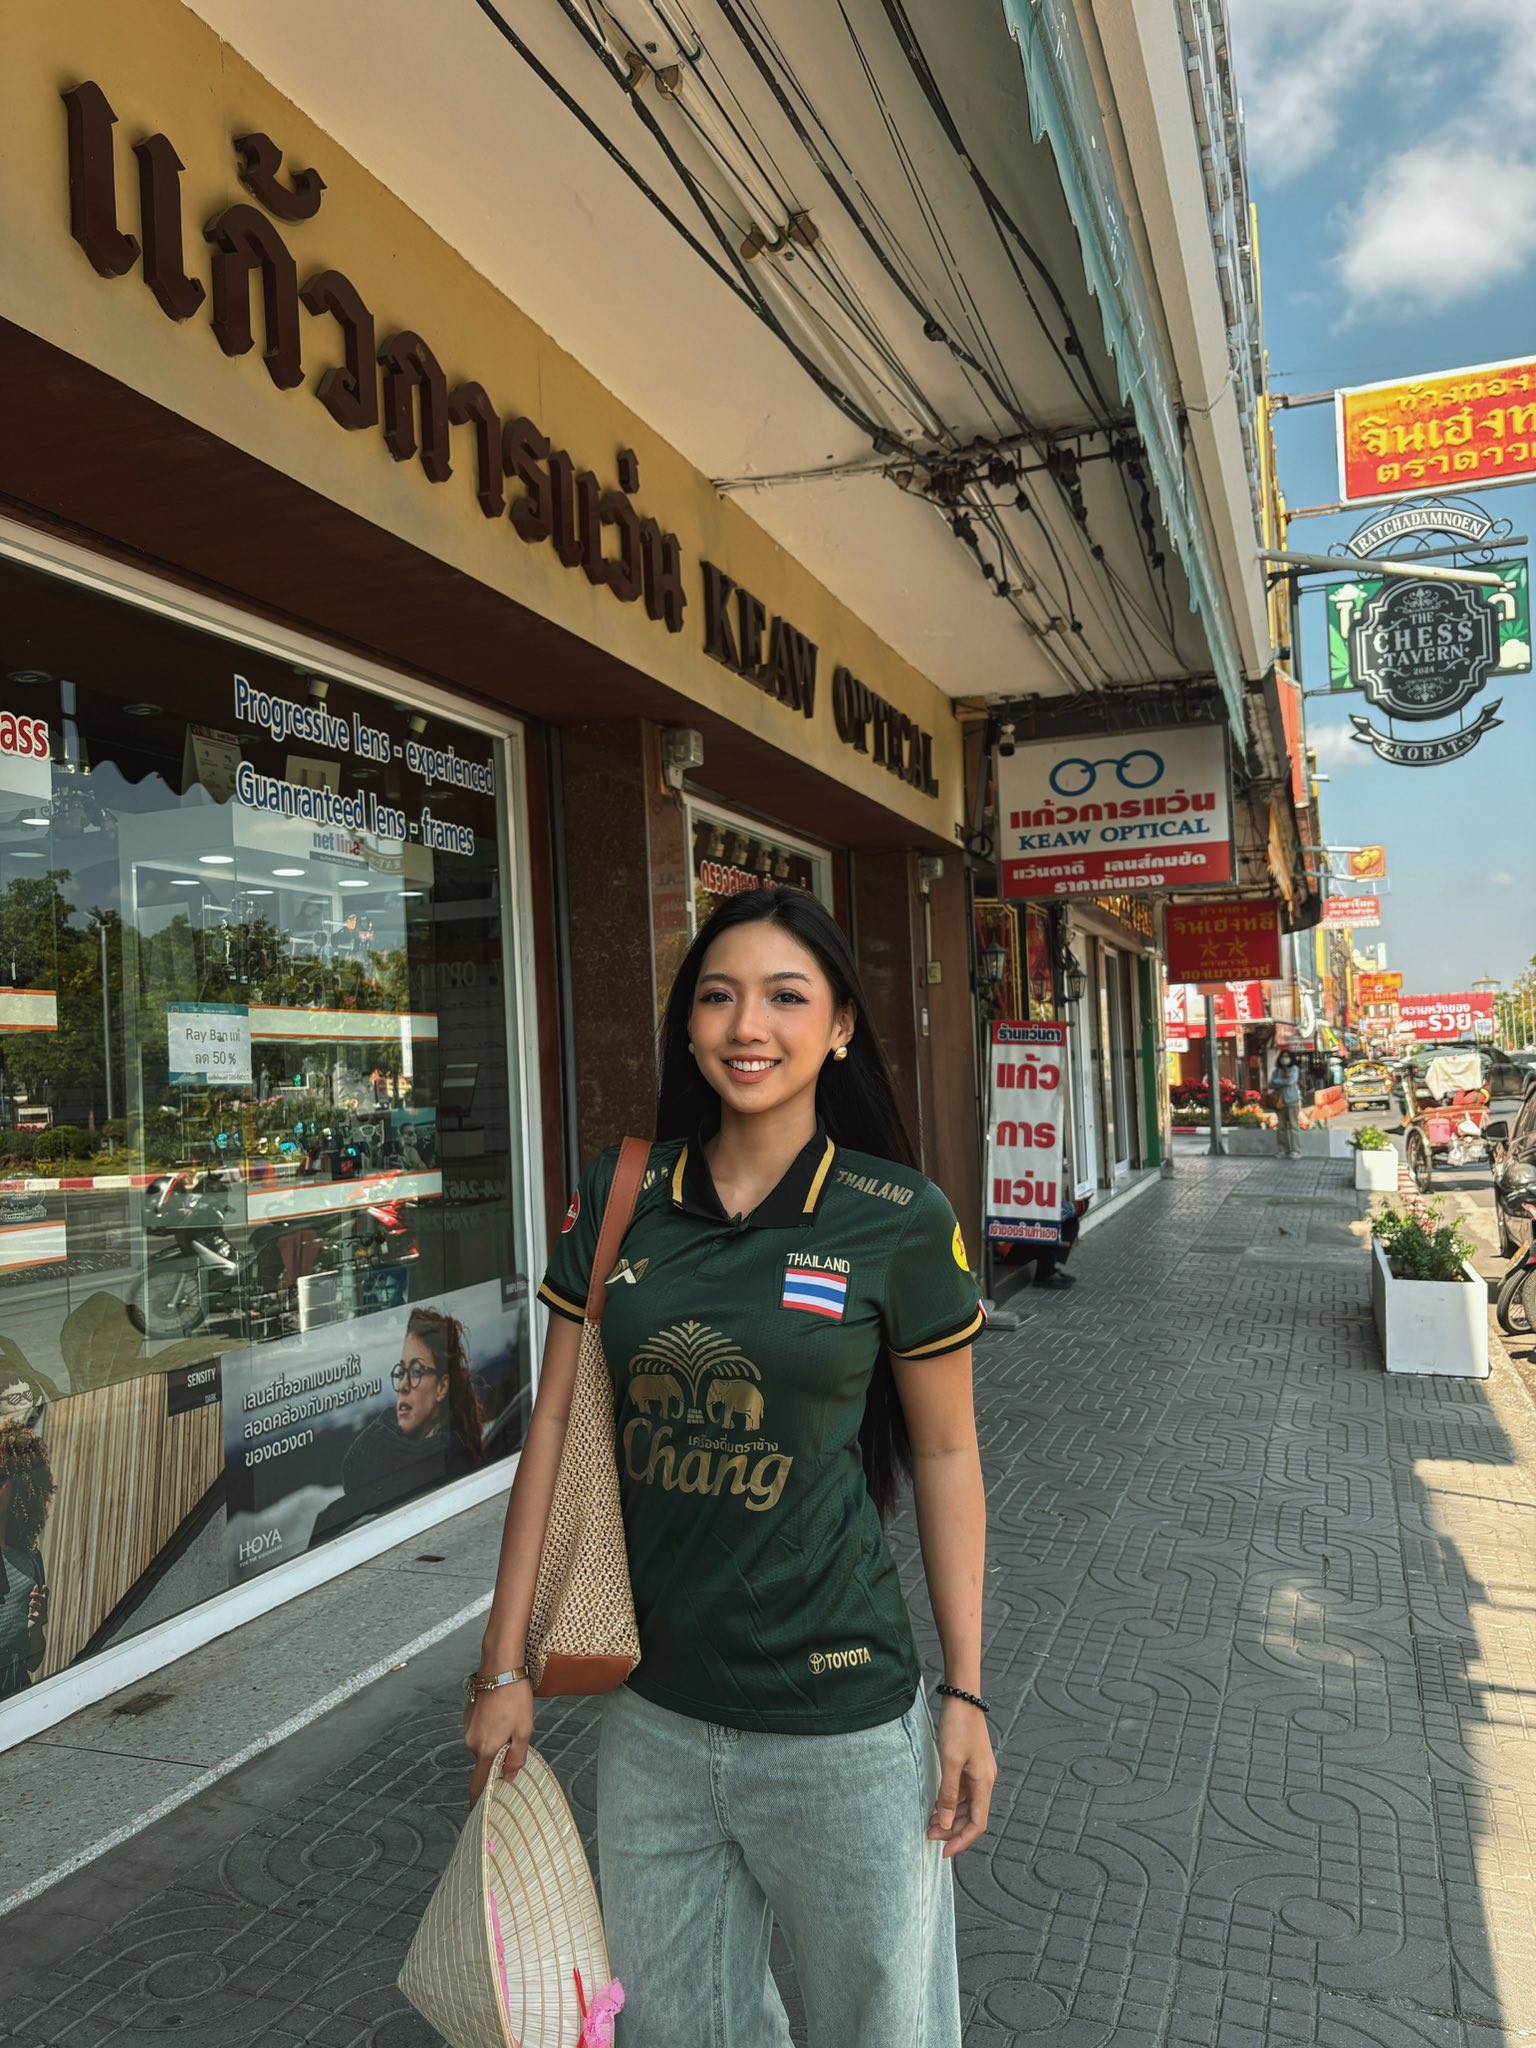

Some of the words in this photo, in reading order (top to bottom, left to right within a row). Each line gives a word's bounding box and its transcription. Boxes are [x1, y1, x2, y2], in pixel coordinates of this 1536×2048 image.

[60, 80, 688, 633] แก้วการแว่น
[1357, 511, 1482, 550] RATCHADAMNOEN
[1409, 611, 1435, 625] THE
[1373, 620, 1474, 654] CHESS
[1383, 643, 1464, 667] TAVERN
[700, 560, 819, 719] KEAW
[832, 665, 938, 799] OPTICAL
[234, 673, 350, 752] Progressive
[353, 712, 391, 763] lens
[406, 741, 496, 796] experienced
[1393, 739, 1459, 761] KORAT
[236, 761, 366, 832] Guanranteed
[370, 792, 406, 842] lens
[421, 806, 475, 857] frames
[1010, 789, 1215, 829] แก้วการแว่น
[1019, 829, 1091, 851] KEAW
[1100, 818, 1210, 843] OPTICAL
[1013, 860, 1086, 880] แว่นตาดี
[1104, 851, 1206, 873] เลนส์คมชัด
[1054, 873, 1165, 894] ราคากันเอง
[186, 1028, 206, 1043] Ray
[210, 1028, 227, 1042] Ban
[998, 1025, 1061, 1041] ร้านแว่นตา
[213, 1051, 226, 1064] 50
[996, 1053, 1060, 1090] แก้ว
[996, 1120, 1056, 1149] การ
[837, 1170, 914, 1206] THAILAND
[993, 1171, 1057, 1207] แว่น
[787, 1252, 850, 1273] THAILAND
[187, 1367, 216, 1388] SENSITY
[243, 1353, 361, 1411] เลนส์ที่ออกแบบมาให้
[244, 1377, 382, 1439] สอดคล้องกับการทำงาน
[245, 1429, 314, 1467] ของดวงตา
[688, 1431, 778, 1454] เครื่องดื่มตราช้าง
[623, 1417, 793, 1512] Chang
[239, 1528, 282, 1561] HOYA
[825, 1646, 872, 1670] TOYOTA
